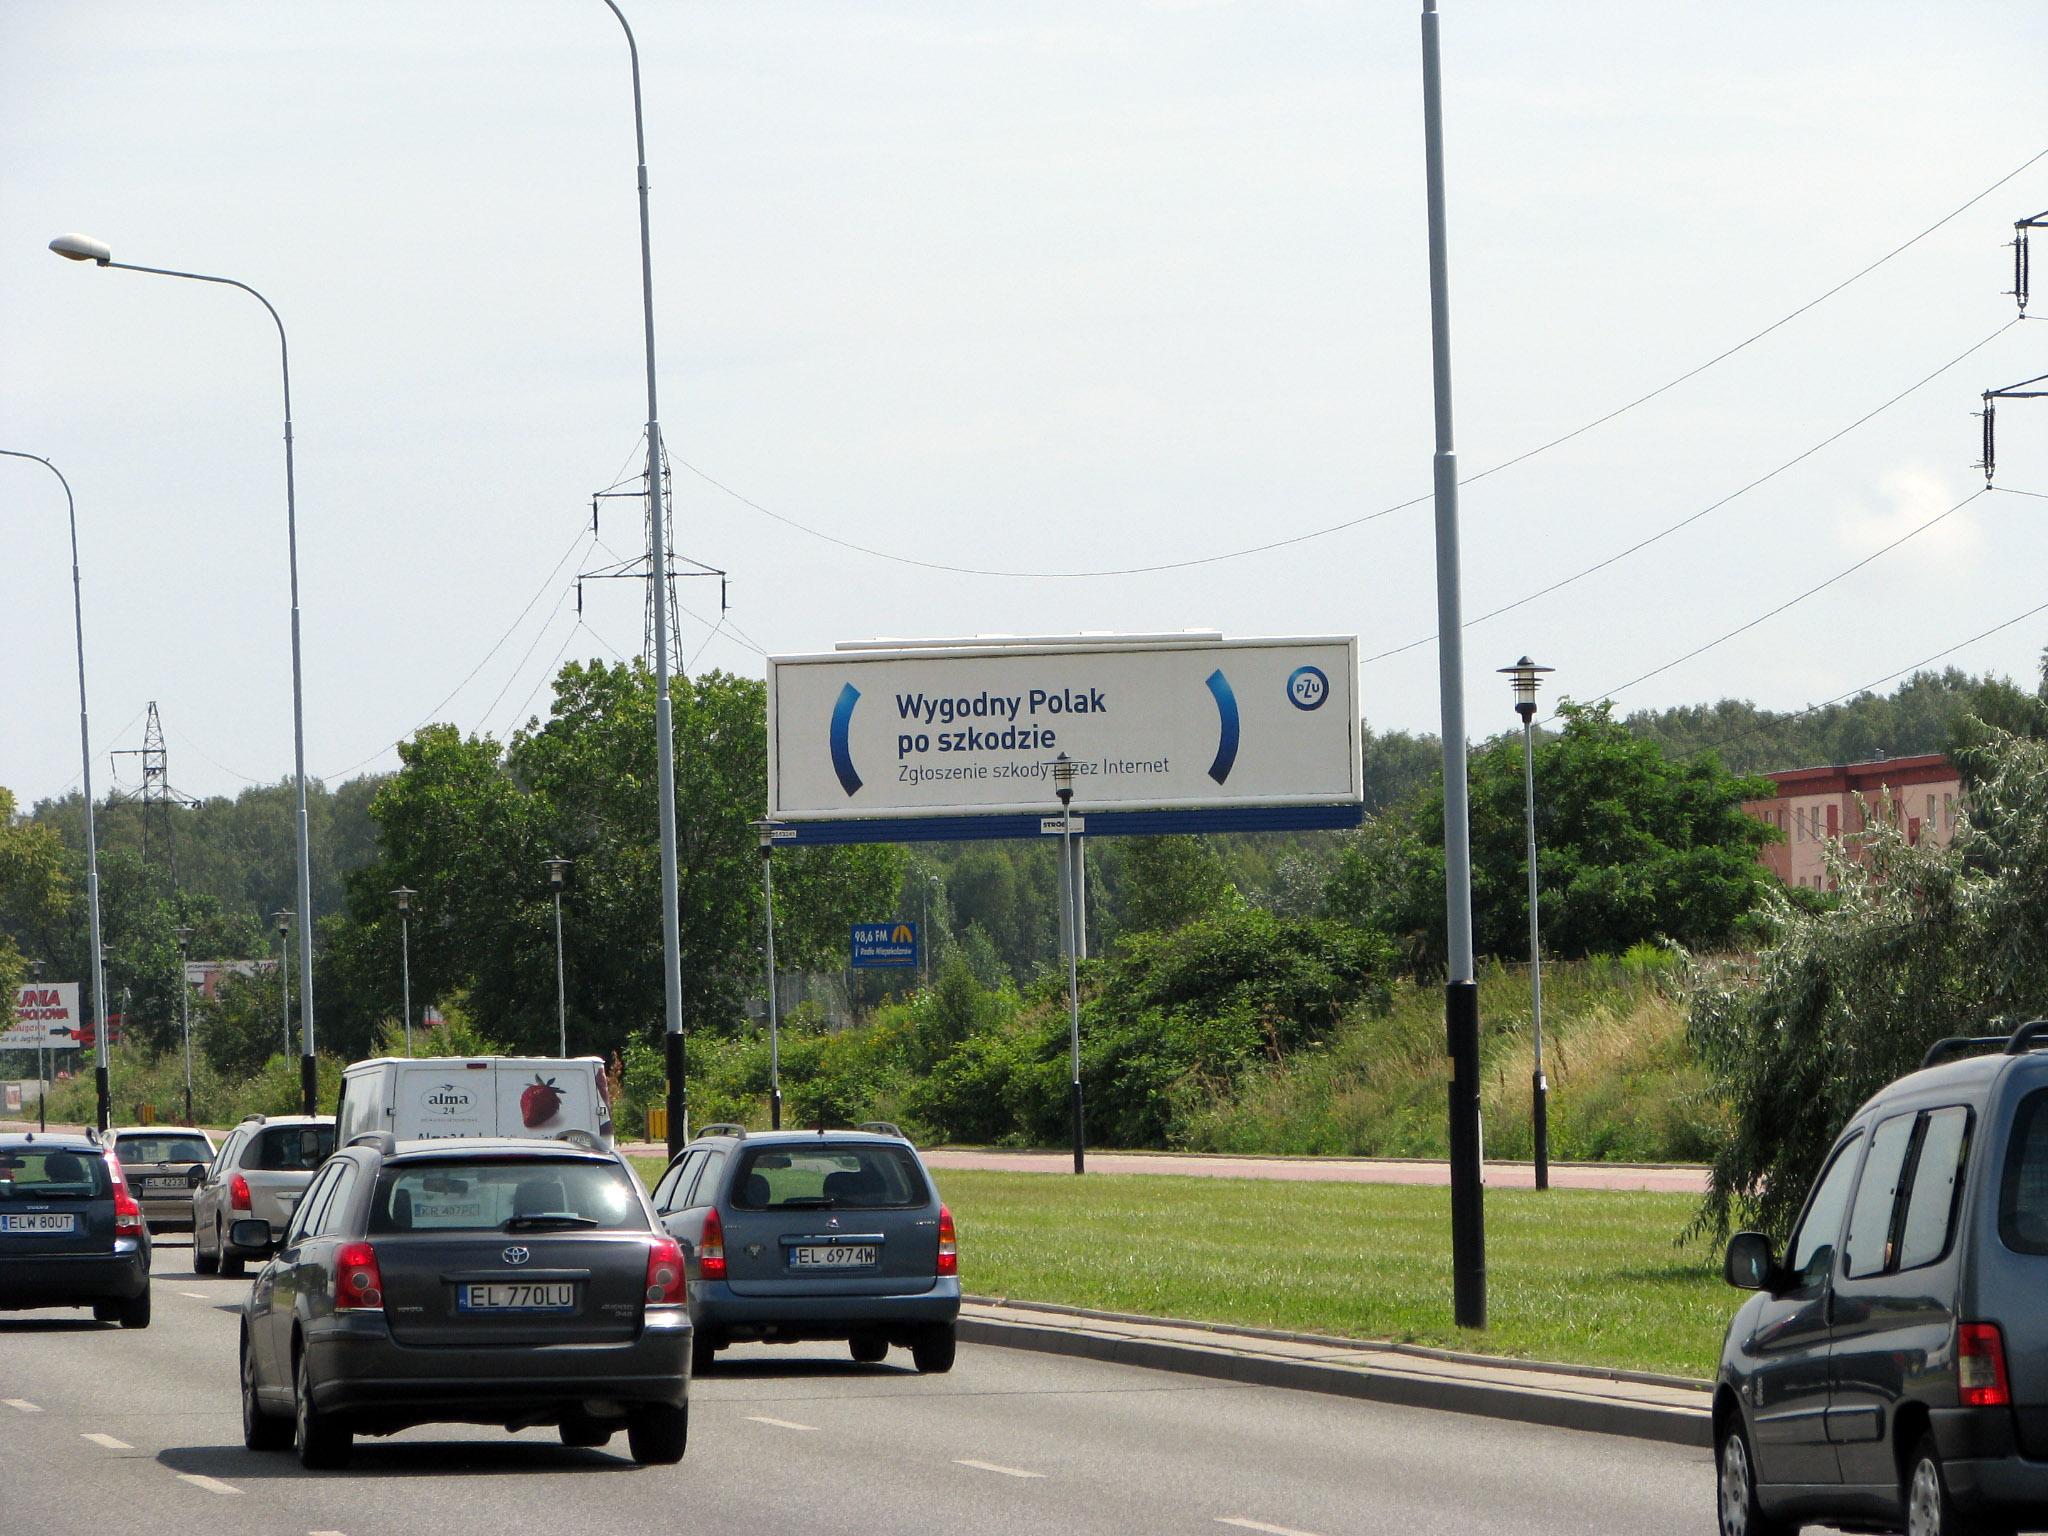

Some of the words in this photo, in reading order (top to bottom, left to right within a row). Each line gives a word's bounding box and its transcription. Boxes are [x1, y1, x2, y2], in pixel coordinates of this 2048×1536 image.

[1296, 679, 1320, 699] PZU
[896, 691, 1022, 724] Wygodny
[1029, 688, 1107, 715] Polak
[898, 733, 930, 760] po
[938, 723, 1056, 752] szkodzie
[898, 763, 988, 786] Zgłoszenie
[992, 761, 1049, 781] szkody
[1053, 763, 1098, 780] zez
[1104, 758, 1170, 775] Internet
[875, 929, 888, 942] FM
[428, 1092, 469, 1105] alma
[442, 1106, 455, 1115] 24
[9, 1216, 37, 1230] ELW
[40, 1215, 72, 1229] 80UT
[799, 1248, 821, 1265] EL
[826, 1247, 875, 1264] 6974W
[470, 1286, 500, 1307] EL
[507, 1285, 572, 1306] 770LU
